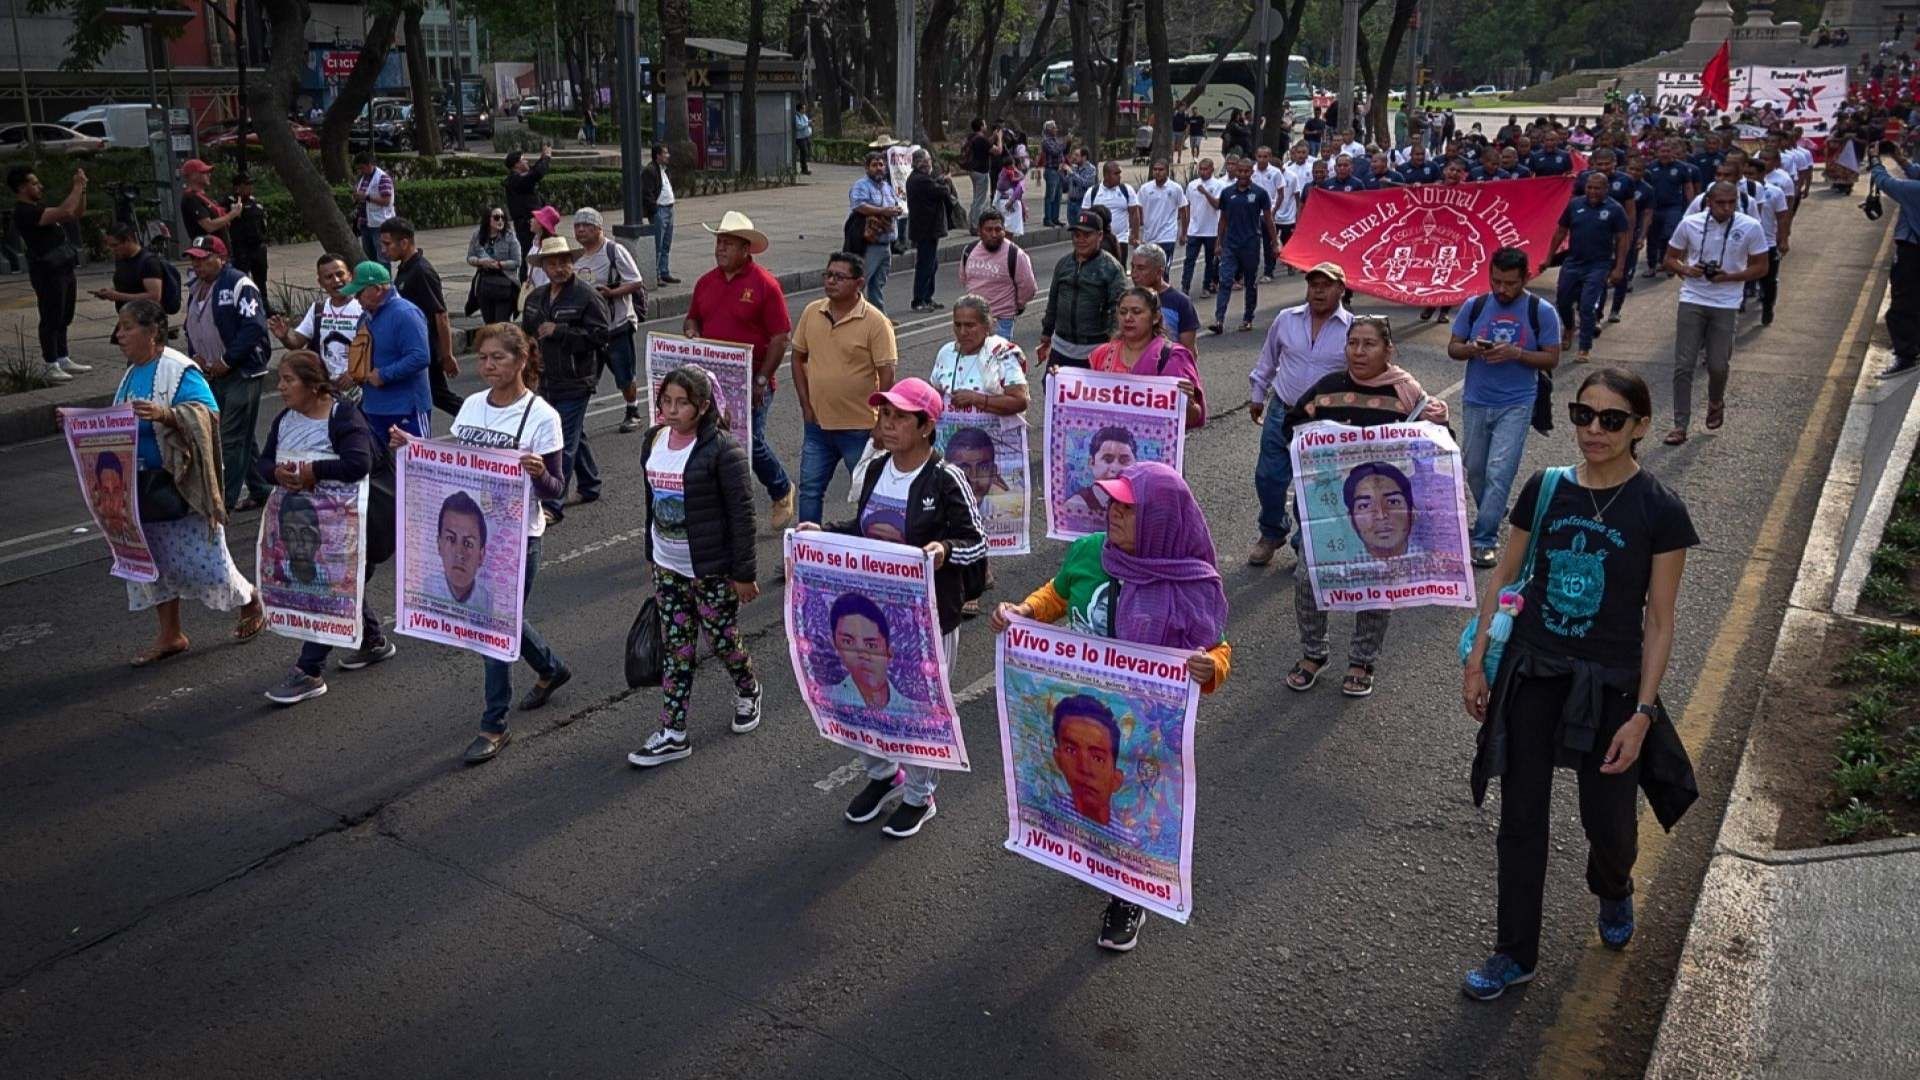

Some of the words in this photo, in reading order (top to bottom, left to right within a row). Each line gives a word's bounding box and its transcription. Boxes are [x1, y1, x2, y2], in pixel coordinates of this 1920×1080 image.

[1320, 201, 1399, 251] Escuela
[1403, 187, 1482, 211] Normal
[1477, 197, 1531, 249] Rural
[654, 340, 676, 352] ¡Vivo
[679, 346, 690, 355] se
[692, 345, 702, 356] lo
[704, 347, 745, 361] llevaron!
[1059, 381, 1177, 410] ¡Justicia!
[1300, 432, 1335, 450] ¡Vivo
[1340, 432, 1357, 443] se
[1362, 427, 1376, 441] lo
[408, 443, 437, 460] ¡Vivo
[440, 452, 453, 464] se
[456, 451, 467, 467] lo
[470, 454, 522, 477] llevaron!
[794, 543, 824, 564] ¡Vivo
[827, 552, 842, 566] se
[846, 552, 857, 569] lo
[861, 554, 924, 579] llevaron!
[1330, 590, 1363, 604] ¡Vivo
[1367, 588, 1381, 600] lo
[1386, 583, 1458, 601] queremos!
[304, 616, 311, 629] lo
[312, 620, 353, 636] queremos!
[410, 612, 439, 629] ¡Vivo
[441, 620, 452, 634] lo
[454, 625, 510, 650] queremos!
[1007, 627, 1050, 652] ¡Vivo
[1055, 641, 1076, 658] se
[1082, 642, 1099, 663] lo
[1104, 647, 1187, 682] llevaron!
[829, 721, 858, 741] ¡Vivo
[860, 730, 873, 744] lo
[876, 740, 951, 759] queremos!
[1026, 829, 1064, 856] ¡Vivo
[1068, 845, 1082, 863] lo
[1086, 857, 1171, 900] queremos!
